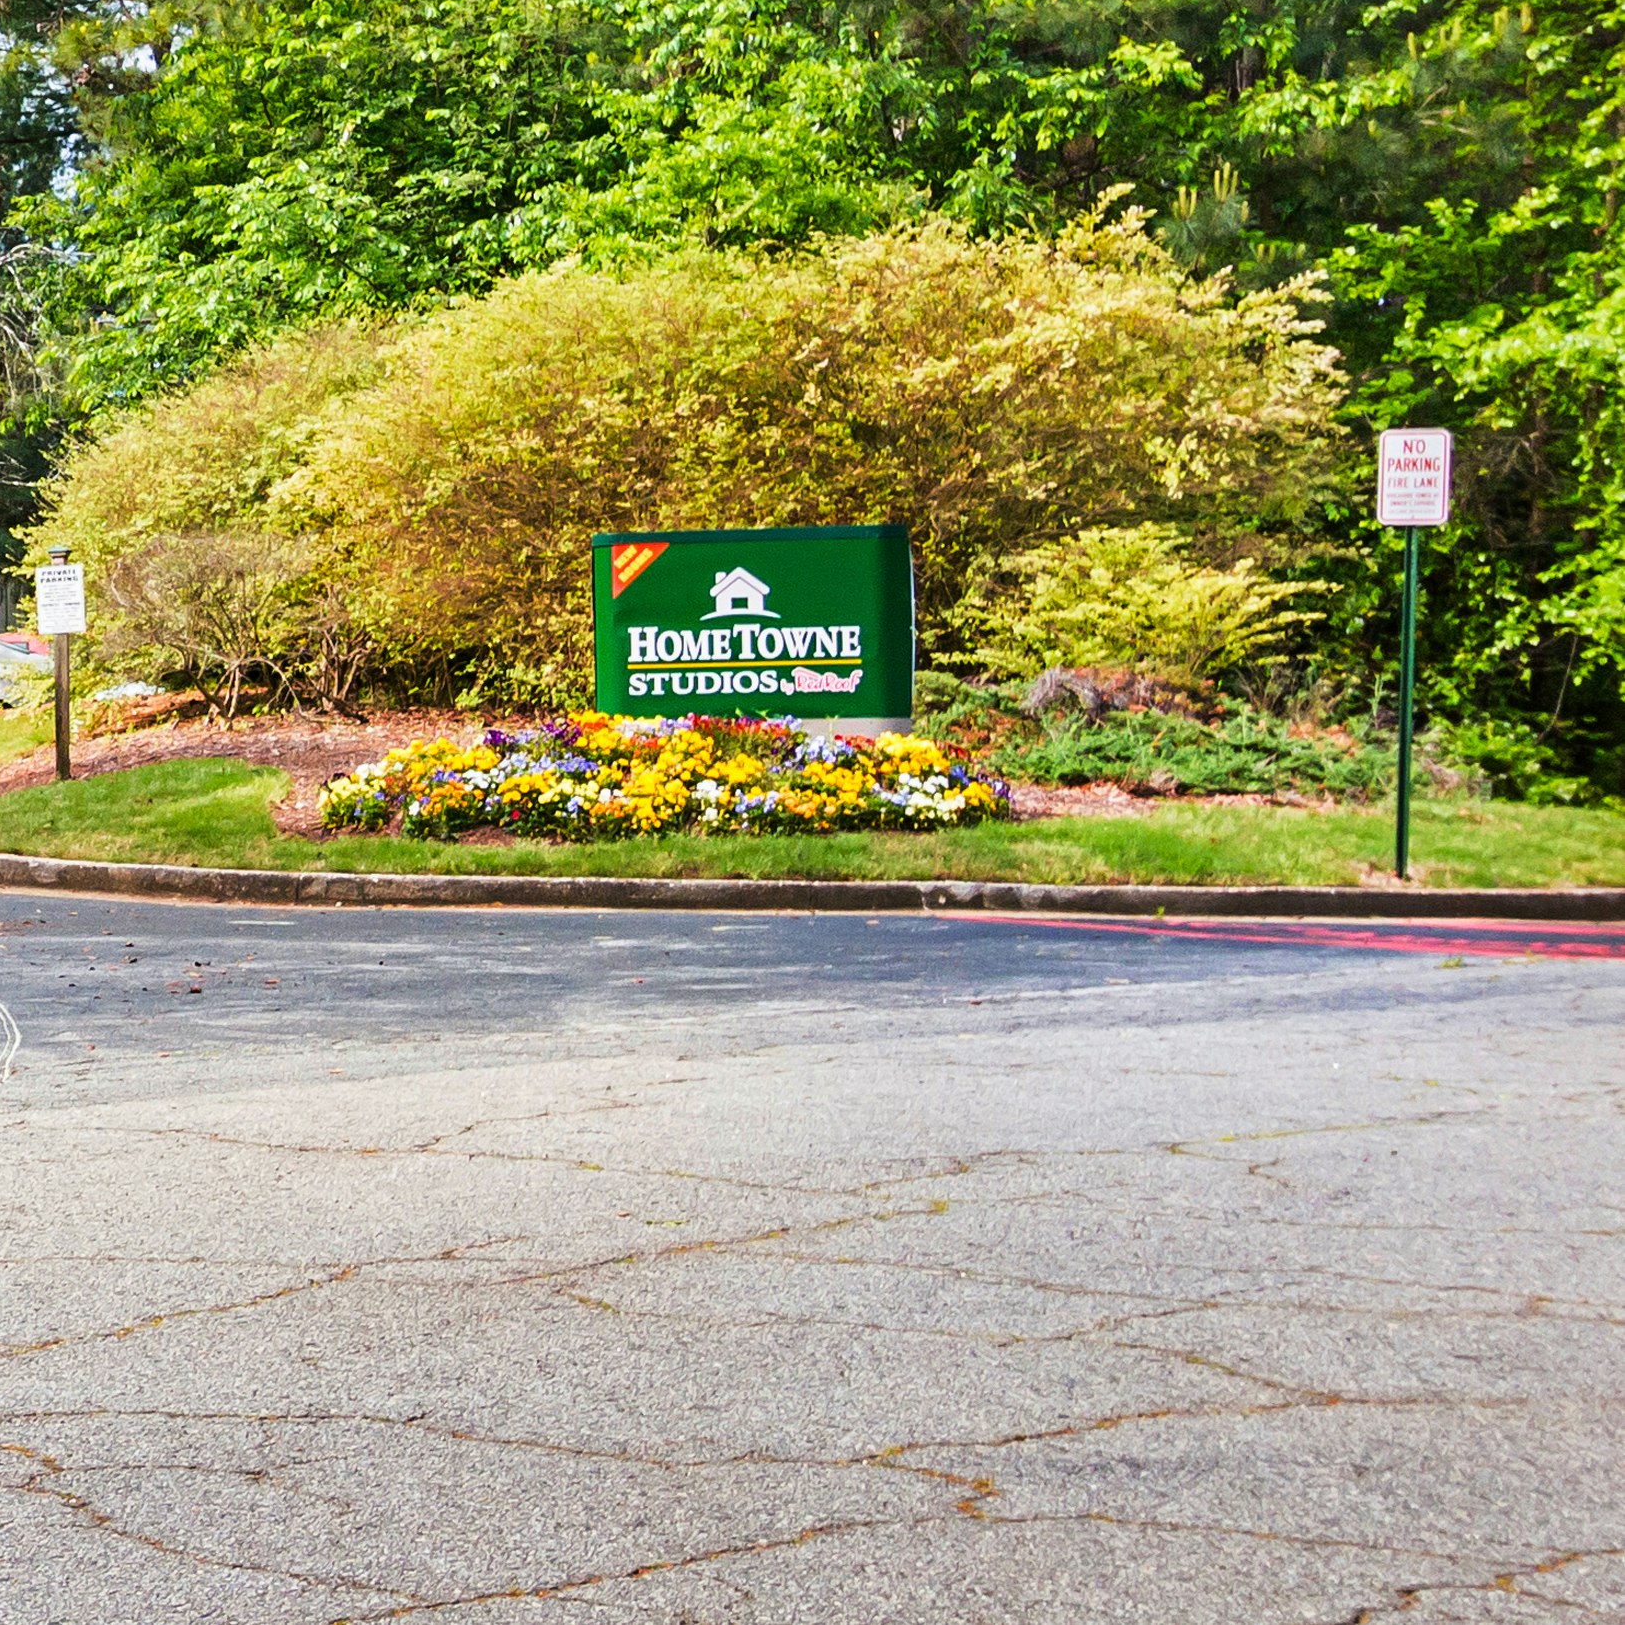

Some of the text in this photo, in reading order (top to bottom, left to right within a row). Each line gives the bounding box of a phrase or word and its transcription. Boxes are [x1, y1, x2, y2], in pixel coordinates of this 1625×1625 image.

[1403, 439, 1426, 454] NO
[1387, 457, 1441, 472] PARKING
[1387, 477, 1439, 488] FIRE LANE
[613, 544, 637, 569] NEW
[628, 670, 778, 696] STUDIOS
